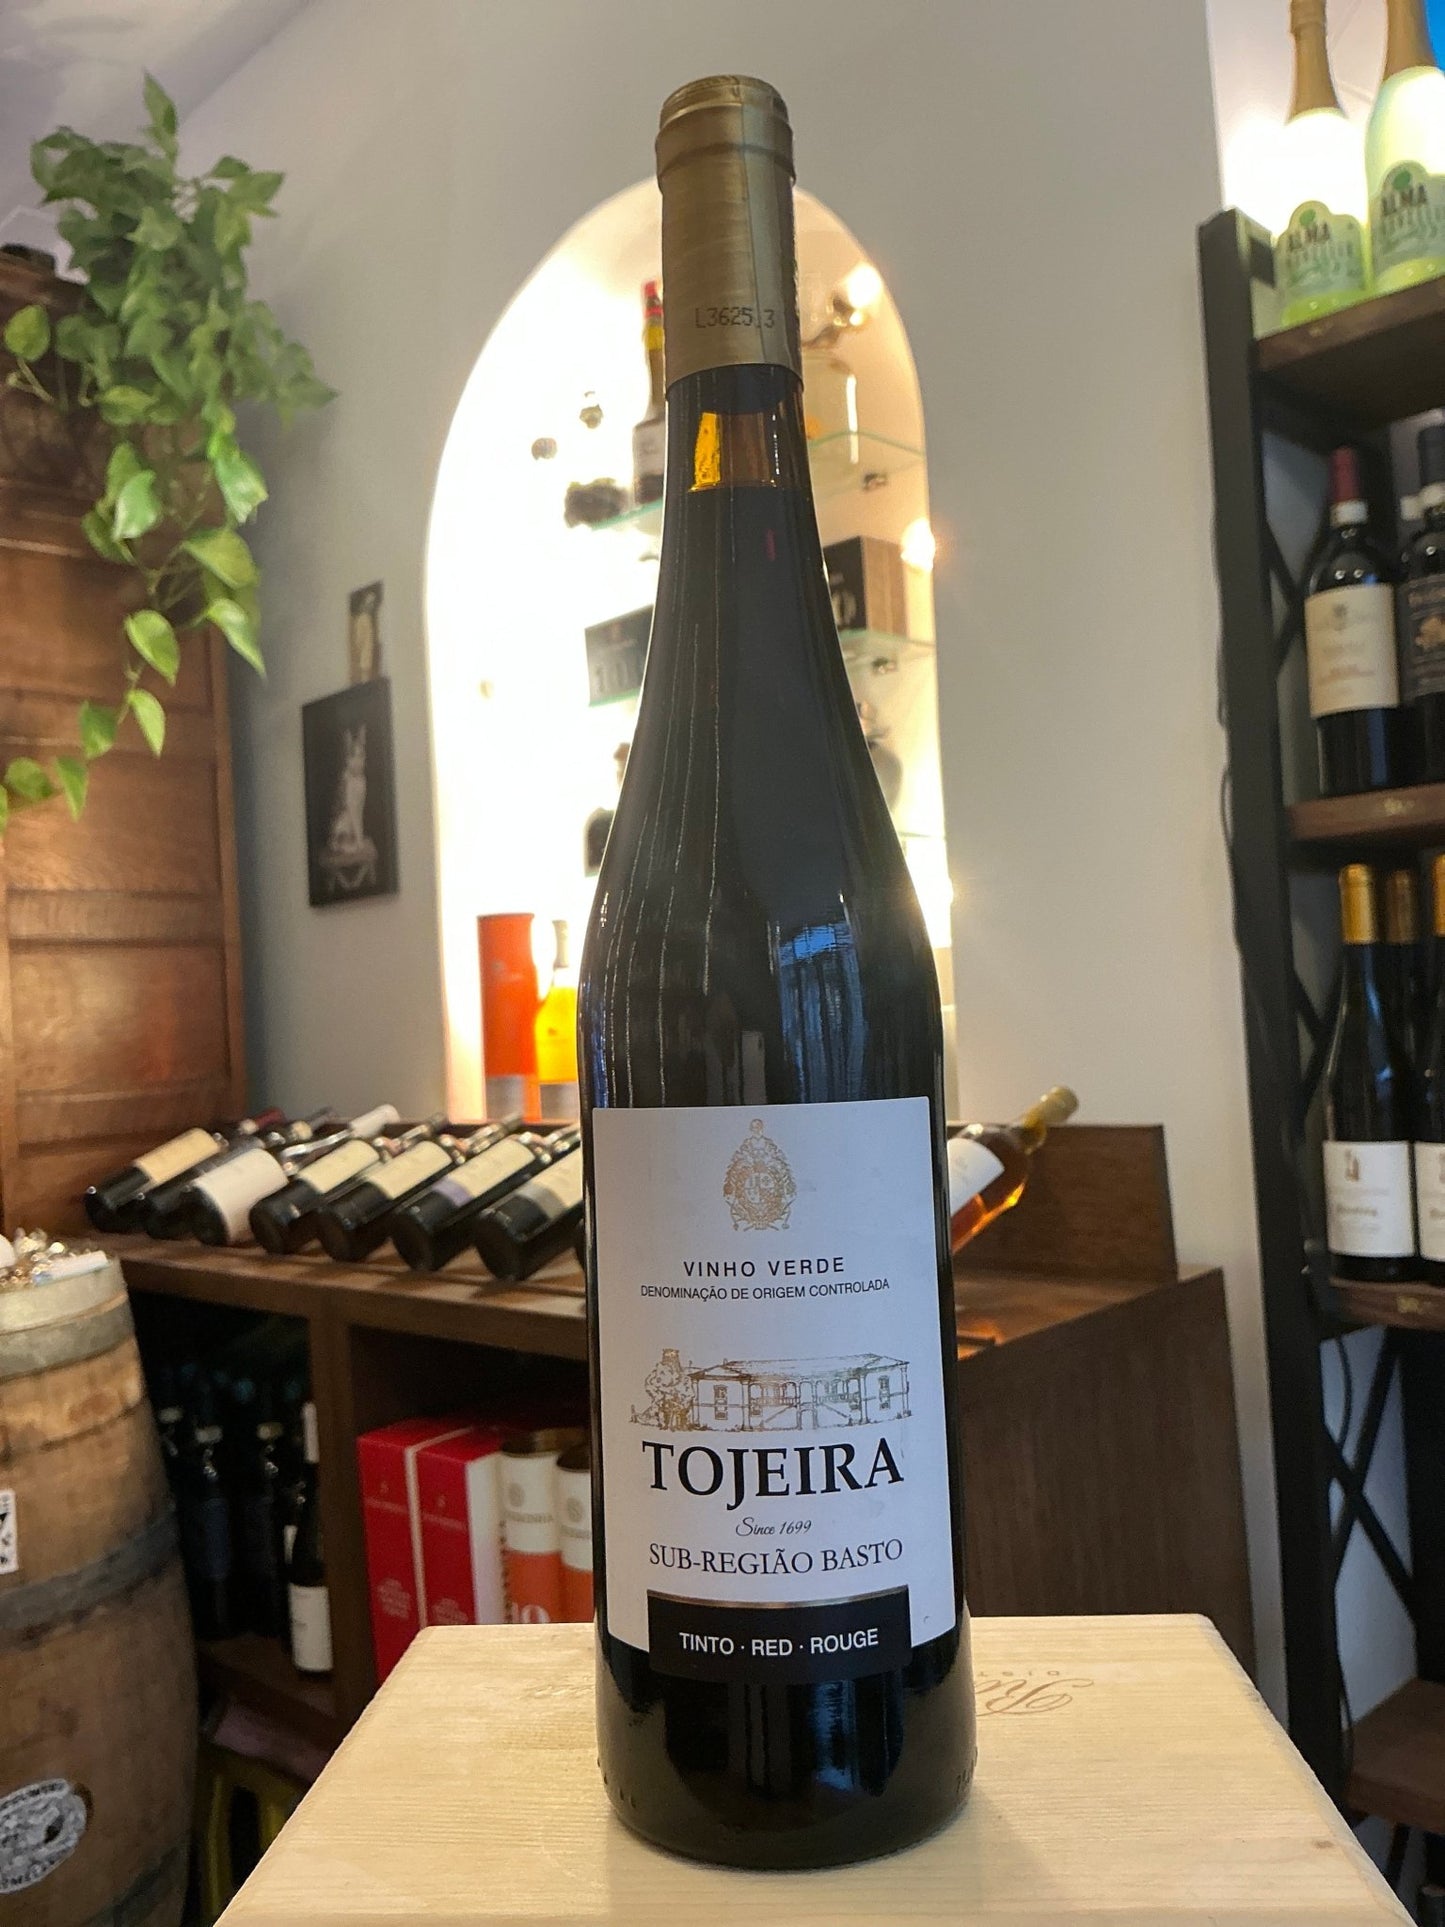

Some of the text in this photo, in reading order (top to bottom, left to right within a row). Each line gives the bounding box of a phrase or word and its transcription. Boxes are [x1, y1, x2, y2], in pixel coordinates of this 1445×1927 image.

[683, 1257, 845, 1277] VINHO VERDE
[640, 1278, 890, 1302] DENOMINAÇÃO DE ORIGEM CONTROLADA
[641, 1437, 905, 1511] TOJEIRA
[735, 1516, 812, 1537] Since 1699
[649, 1538, 904, 1575] SUB-REGIÃO BASTO
[679, 1628, 879, 1656] TINTO RED ROUGE
